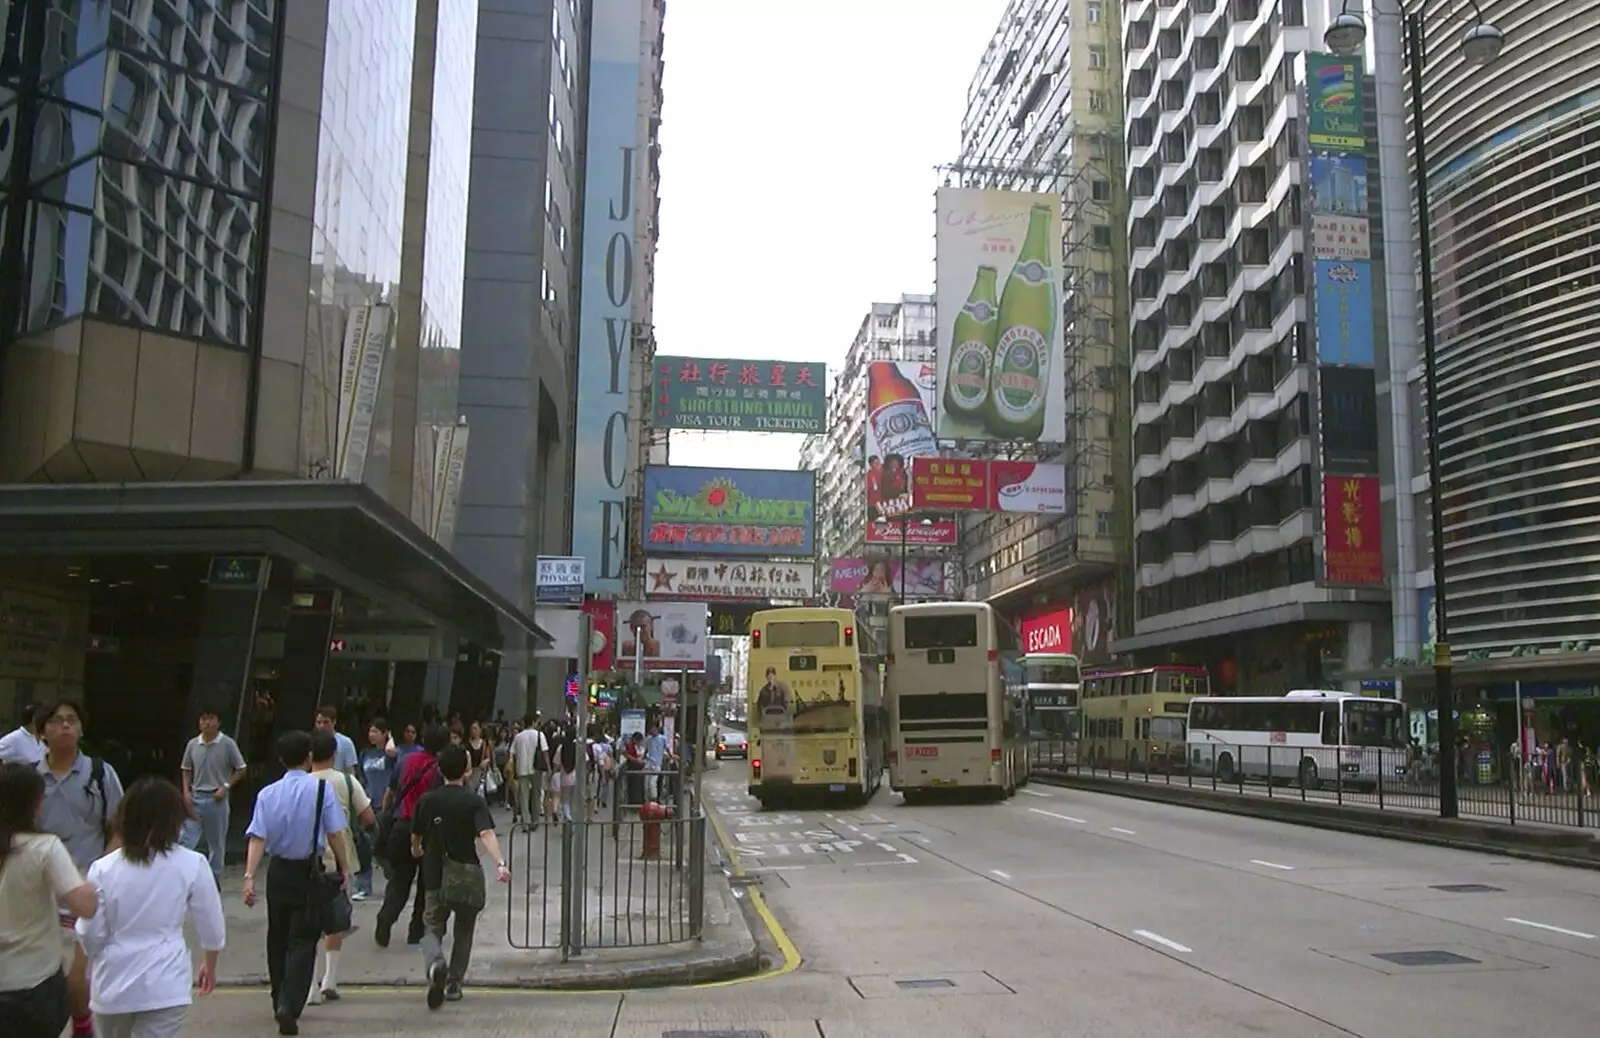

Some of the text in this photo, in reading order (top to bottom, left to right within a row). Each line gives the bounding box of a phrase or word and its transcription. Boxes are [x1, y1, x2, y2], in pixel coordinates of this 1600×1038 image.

[597, 147, 635, 580] JOYCE
[356, 333, 384, 413] SHOPPING
[679, 397, 814, 417] SHOESTRING TRAVEL
[675, 414, 819, 429] VISA TOUR TICKETING
[677, 584, 702, 593] CHINA
[703, 585, 732, 594] TRAVEL
[734, 586, 766, 596] SERVICE
[1029, 624, 1061, 652] ESCADA
[798, 658, 808, 668] 9
[735, 840, 864, 856] STOP
